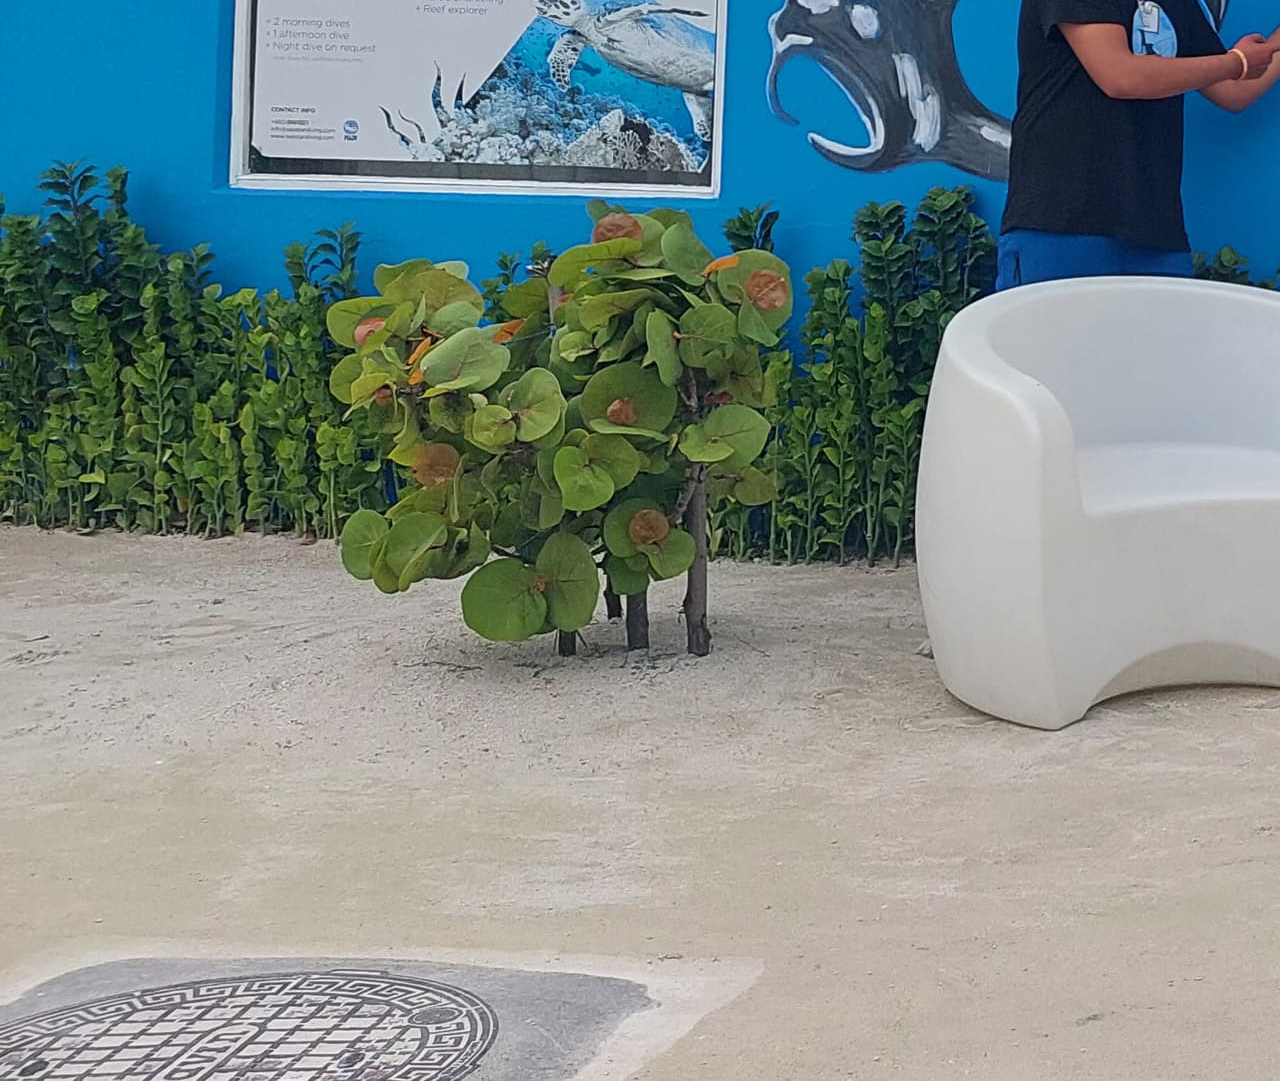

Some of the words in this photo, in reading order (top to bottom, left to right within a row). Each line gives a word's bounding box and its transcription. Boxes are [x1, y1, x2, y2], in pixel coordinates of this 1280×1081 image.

[423, 4, 446, 14] Reef
[447, 6, 488, 16] explorer
[272, 17, 280, 26] 2
[282, 18, 323, 28] morning
[325, 19, 351, 28] dives
[329, 31, 350, 40] dive
[273, 42, 299, 51] Night
[302, 43, 322, 51] dive
[340, 44, 376, 53] request
